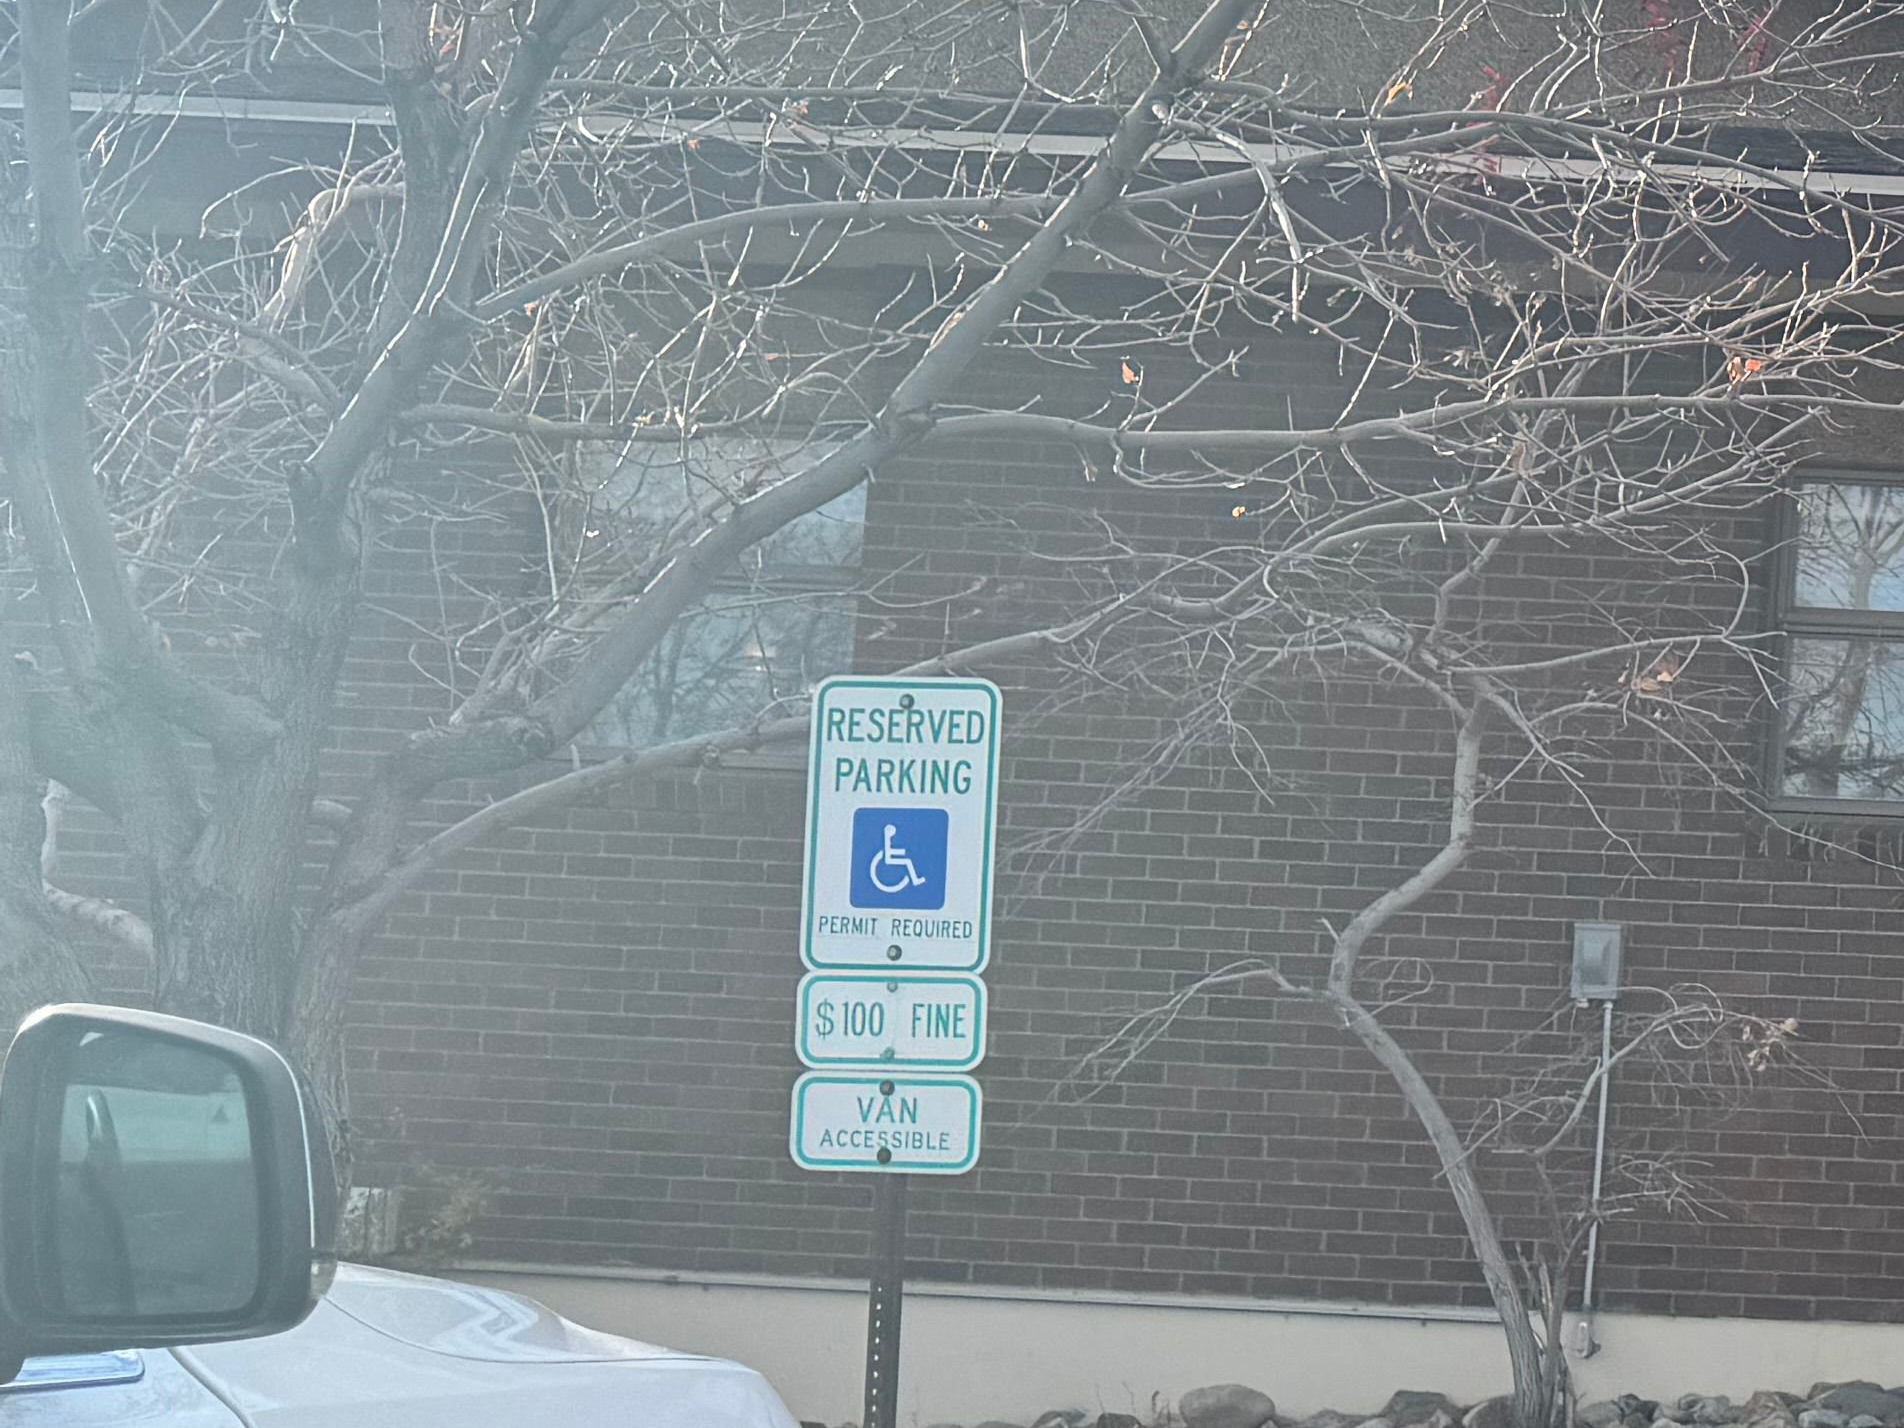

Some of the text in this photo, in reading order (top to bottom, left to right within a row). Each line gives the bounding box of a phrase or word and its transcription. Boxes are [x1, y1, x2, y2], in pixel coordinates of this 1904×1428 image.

[826, 707, 985, 745] RESERVED
[834, 757, 972, 795] PARKING
[819, 915, 972, 939] PERMIT REQUIRED
[815, 999, 967, 1038] $100 FINE
[856, 1097, 918, 1124] VAN
[819, 1128, 951, 1151] ACCESSIBLE
